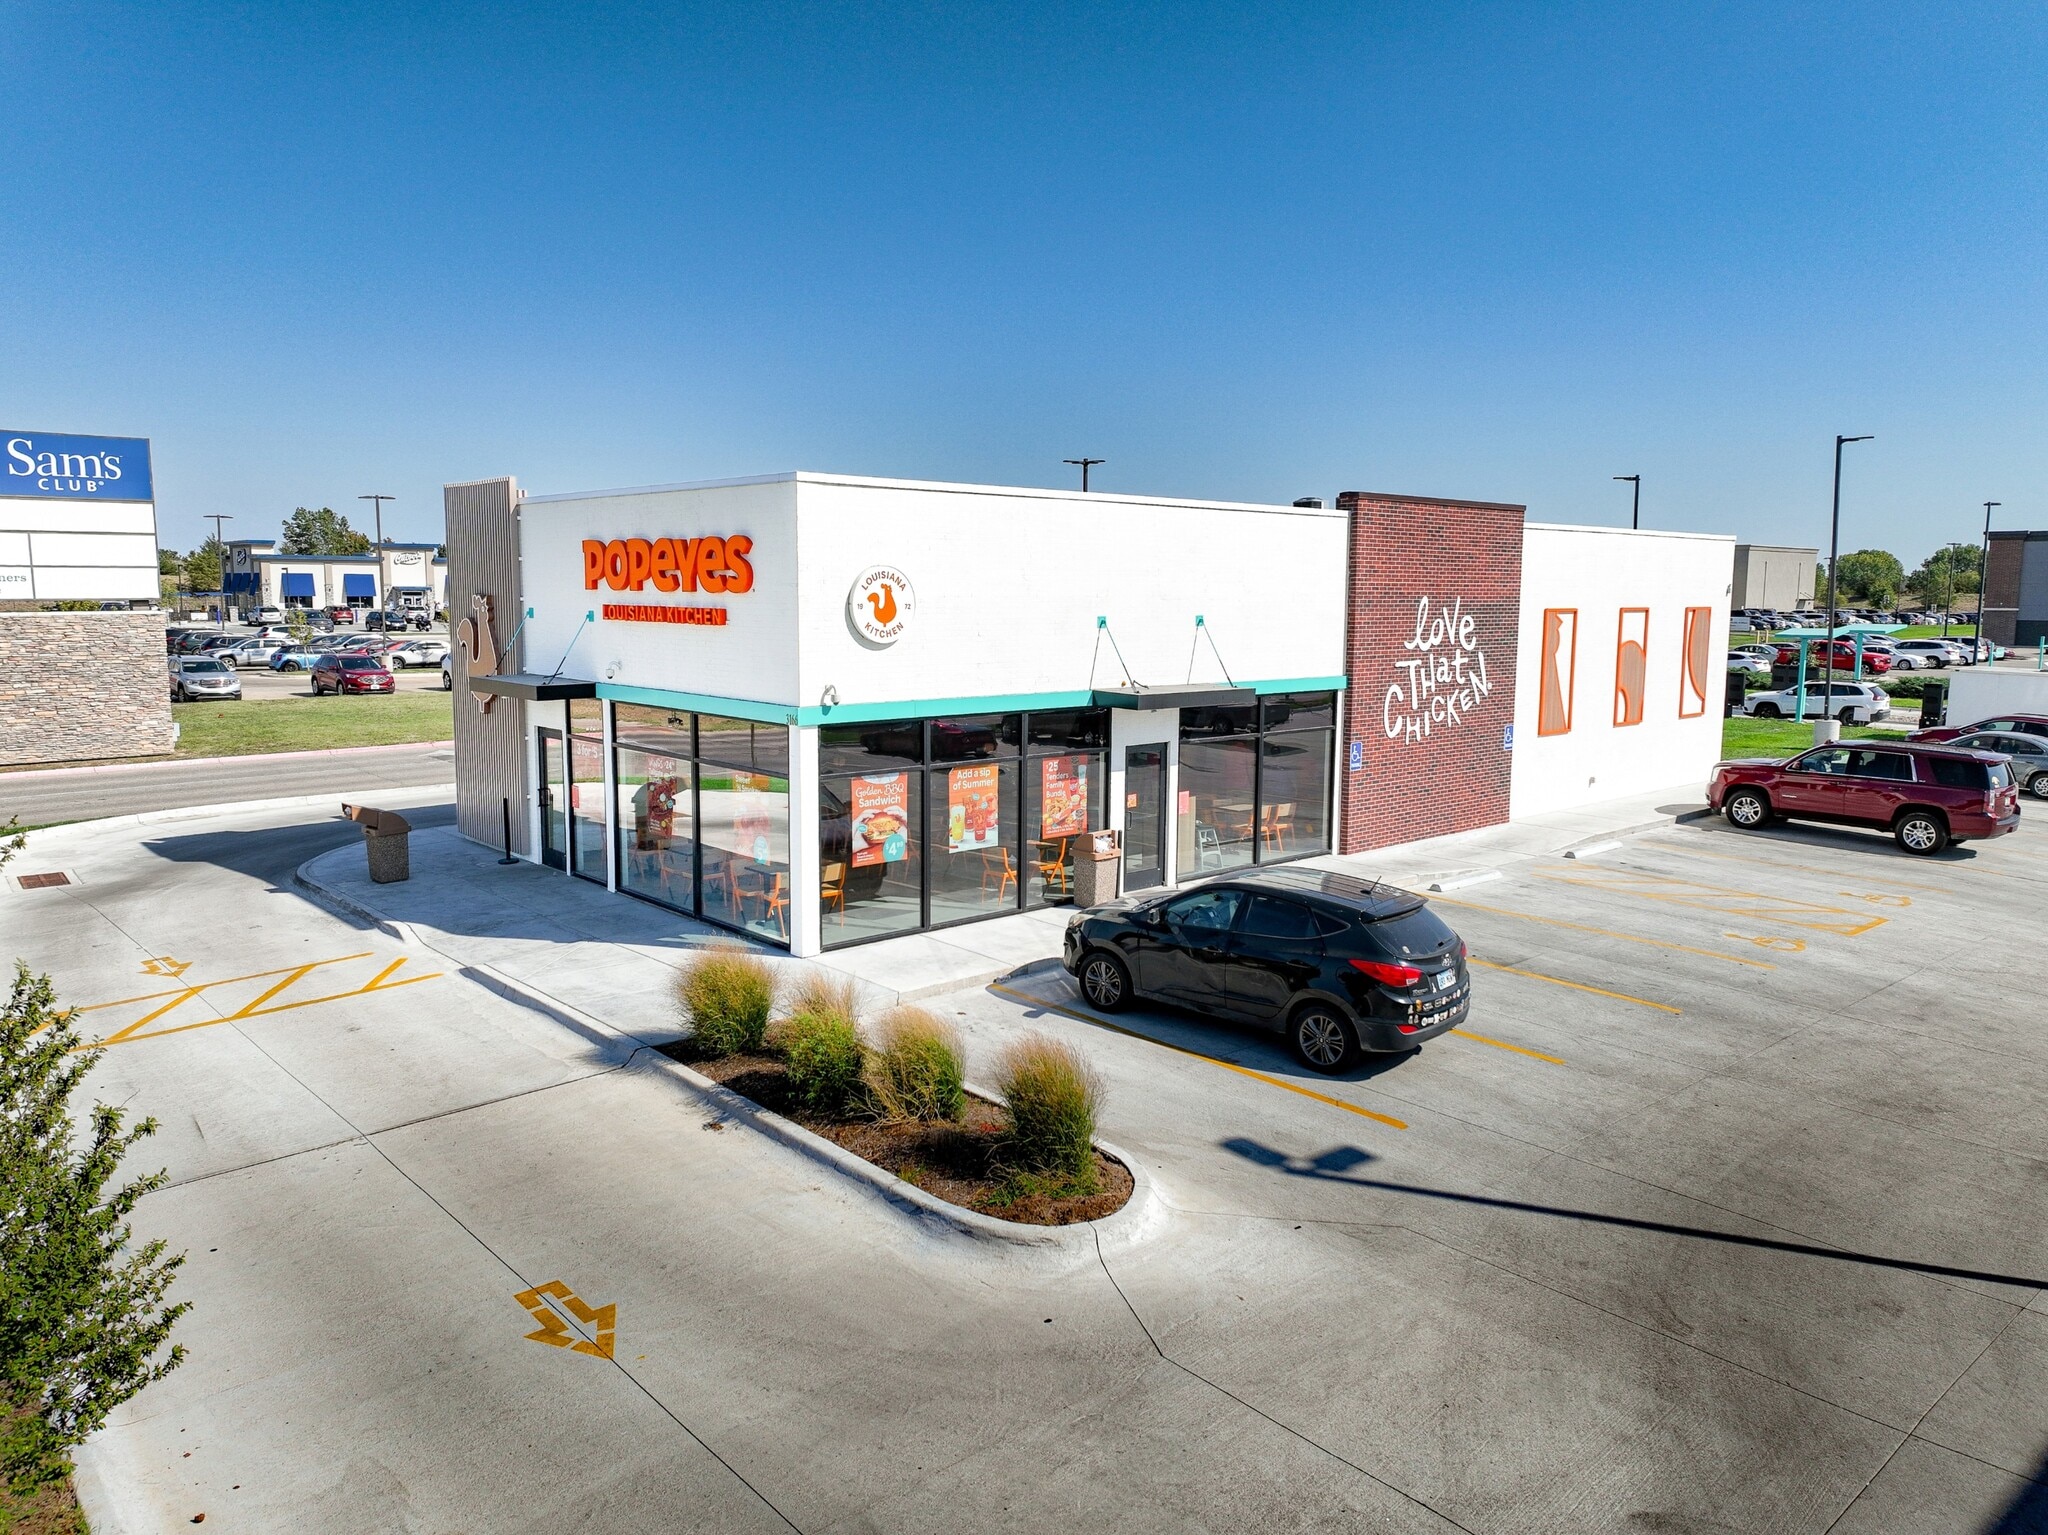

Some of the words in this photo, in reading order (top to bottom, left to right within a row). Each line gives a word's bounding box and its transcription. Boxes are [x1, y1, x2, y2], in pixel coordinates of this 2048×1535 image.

[7, 438, 122, 480] Sam's
[38, 478, 98, 492] CLUB
[861, 571, 907, 591] LOUISIANA
[602, 604, 663, 622] LOUISIANA
[666, 606, 721, 625] KITCHEN
[865, 622, 904, 638] KITCHEN
[957, 768, 973, 779] Add
[979, 767, 991, 779] sip
[855, 786, 883, 798] Golden
[884, 783, 904, 795] BBQ
[952, 781, 962, 790] of
[962, 779, 994, 789] Summer
[858, 795, 901, 808] Sandwich
